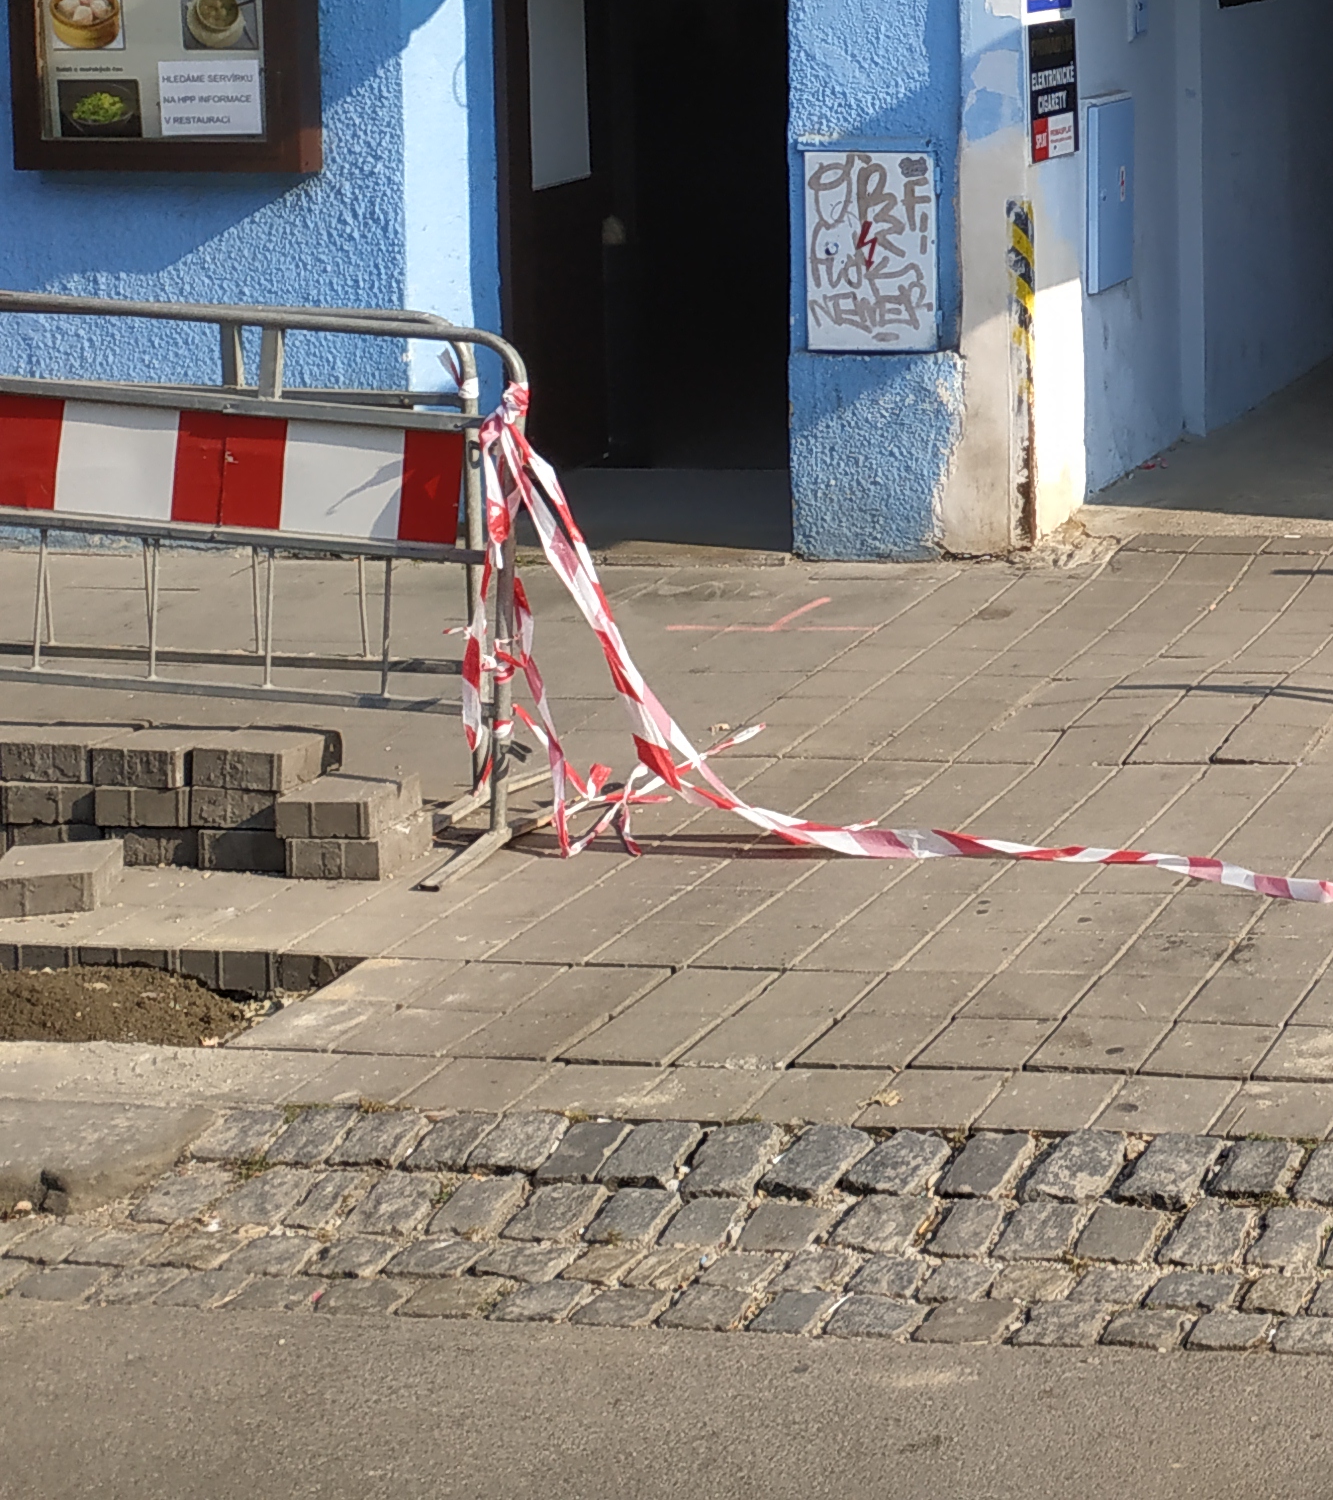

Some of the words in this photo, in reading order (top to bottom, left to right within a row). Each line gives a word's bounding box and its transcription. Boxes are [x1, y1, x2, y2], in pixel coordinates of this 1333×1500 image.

[162, 75, 205, 83] HLEDÁME
[1031, 60, 1075, 92] ELEKTRONICKÉ
[1037, 90, 1067, 115] CIGARETY
